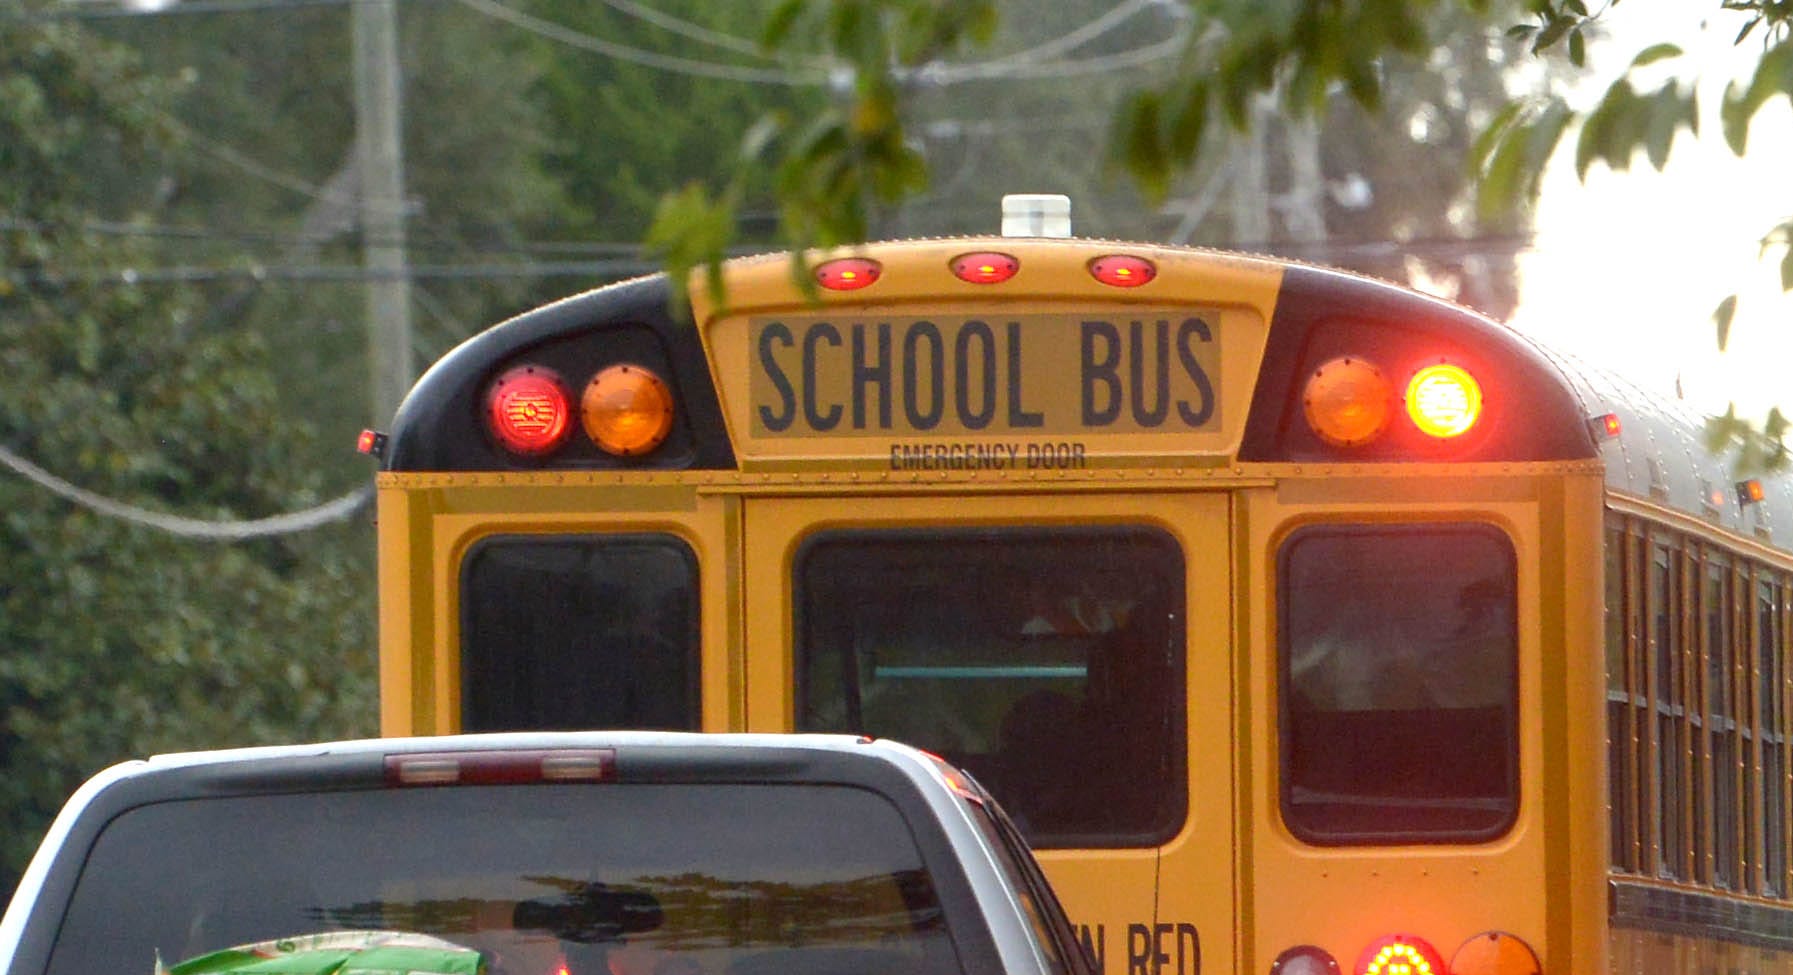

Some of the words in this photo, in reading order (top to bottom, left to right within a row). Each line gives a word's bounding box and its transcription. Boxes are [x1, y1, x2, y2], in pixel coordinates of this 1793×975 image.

[757, 320, 1044, 432] SCHOOL
[1081, 317, 1215, 429] BUS
[889, 444, 1019, 471] EMERGENCY
[1027, 443, 1086, 470] DOOR
